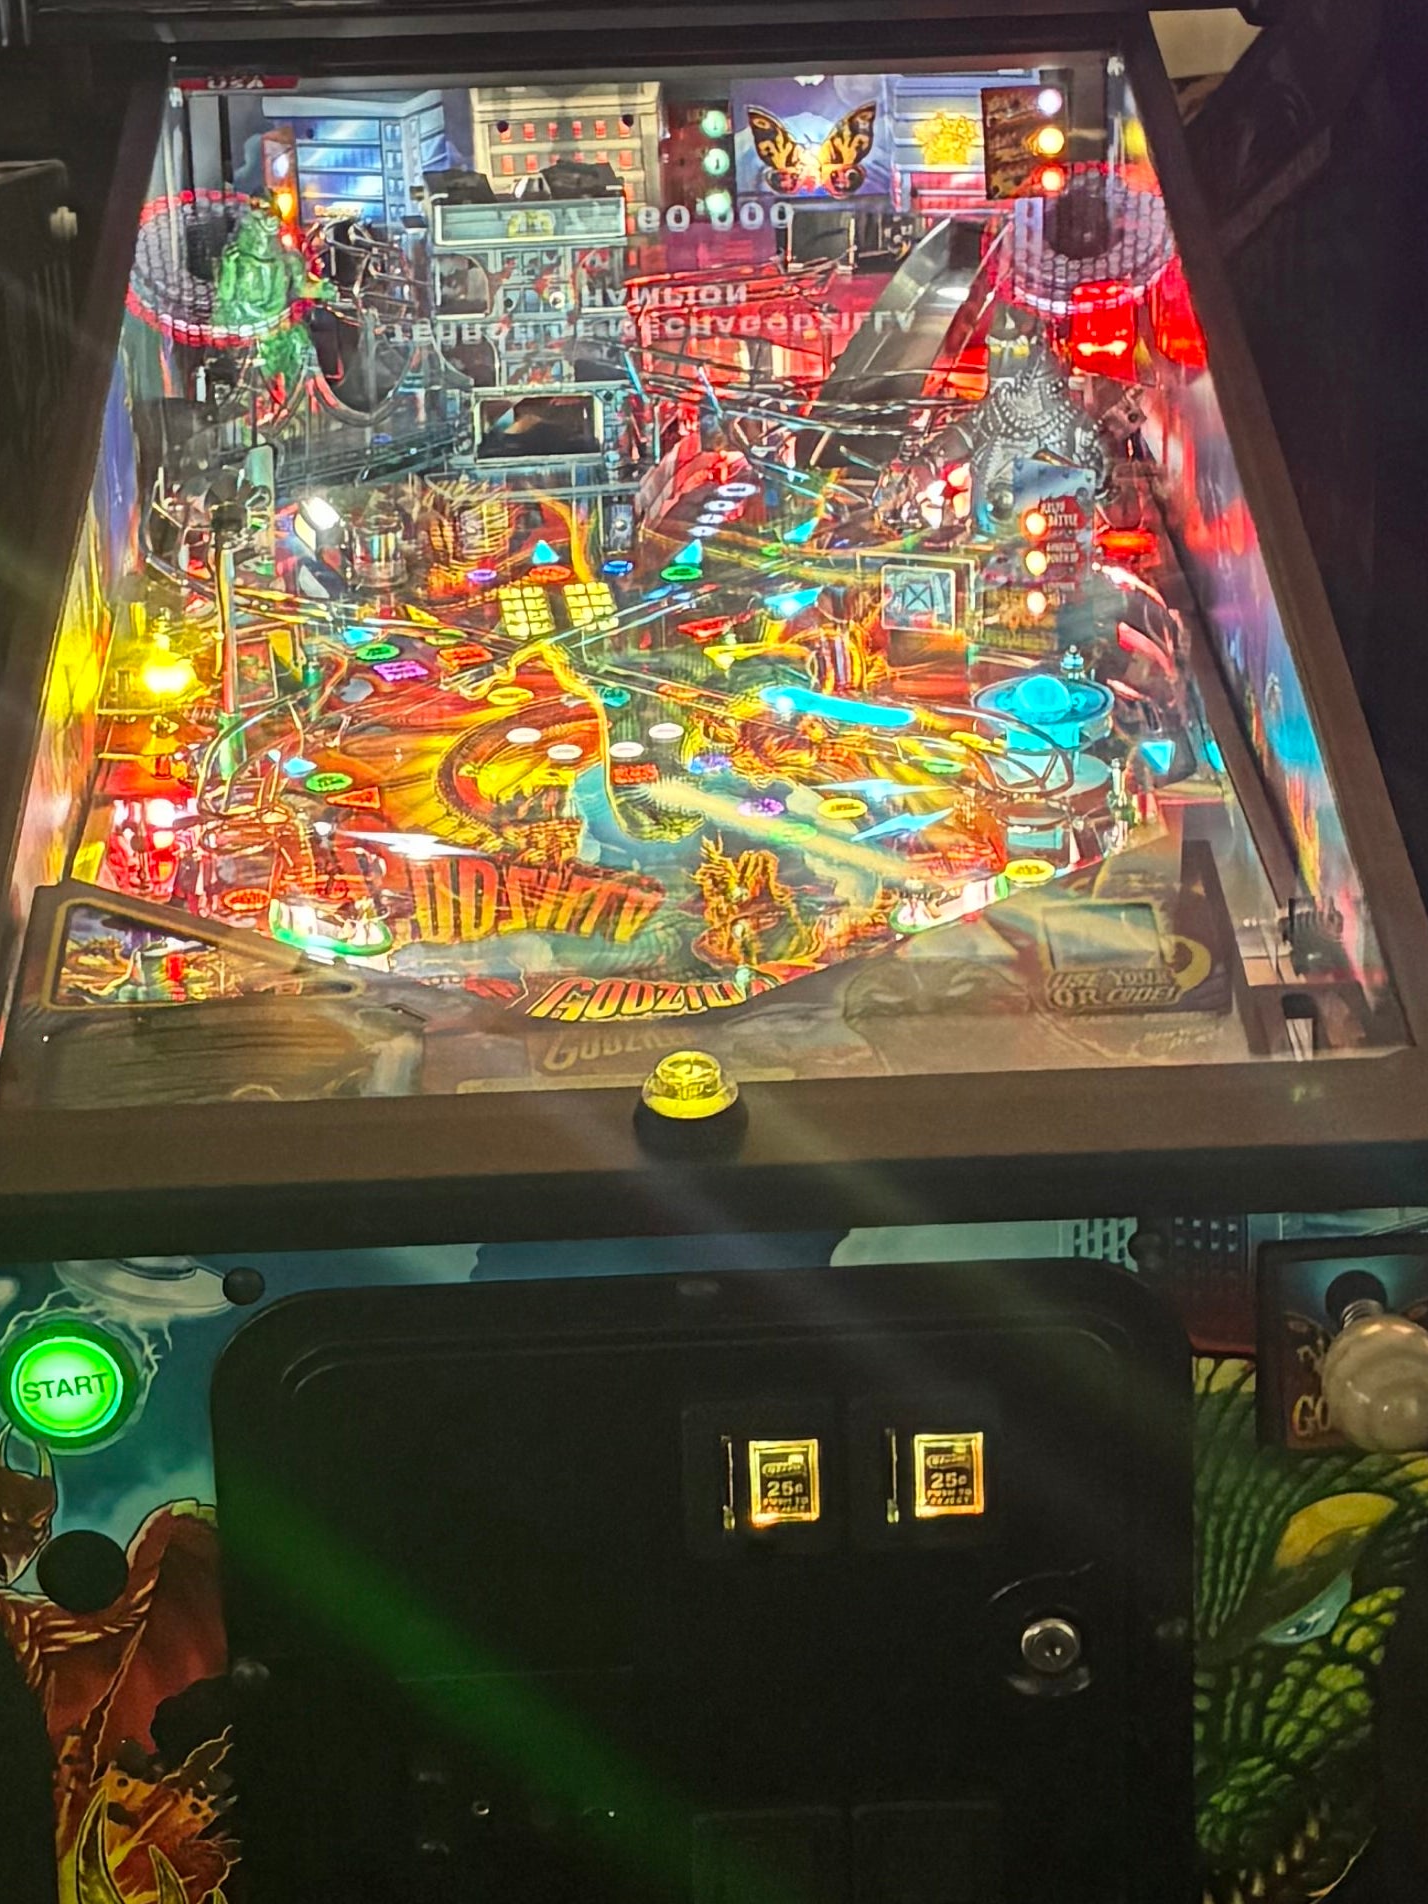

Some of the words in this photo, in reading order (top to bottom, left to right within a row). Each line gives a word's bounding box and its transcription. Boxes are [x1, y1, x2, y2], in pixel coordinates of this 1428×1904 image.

[526, 976, 791, 1023] GODZILLA
[543, 1028, 696, 1072] GODZILL
[22, 1371, 109, 1403] START
